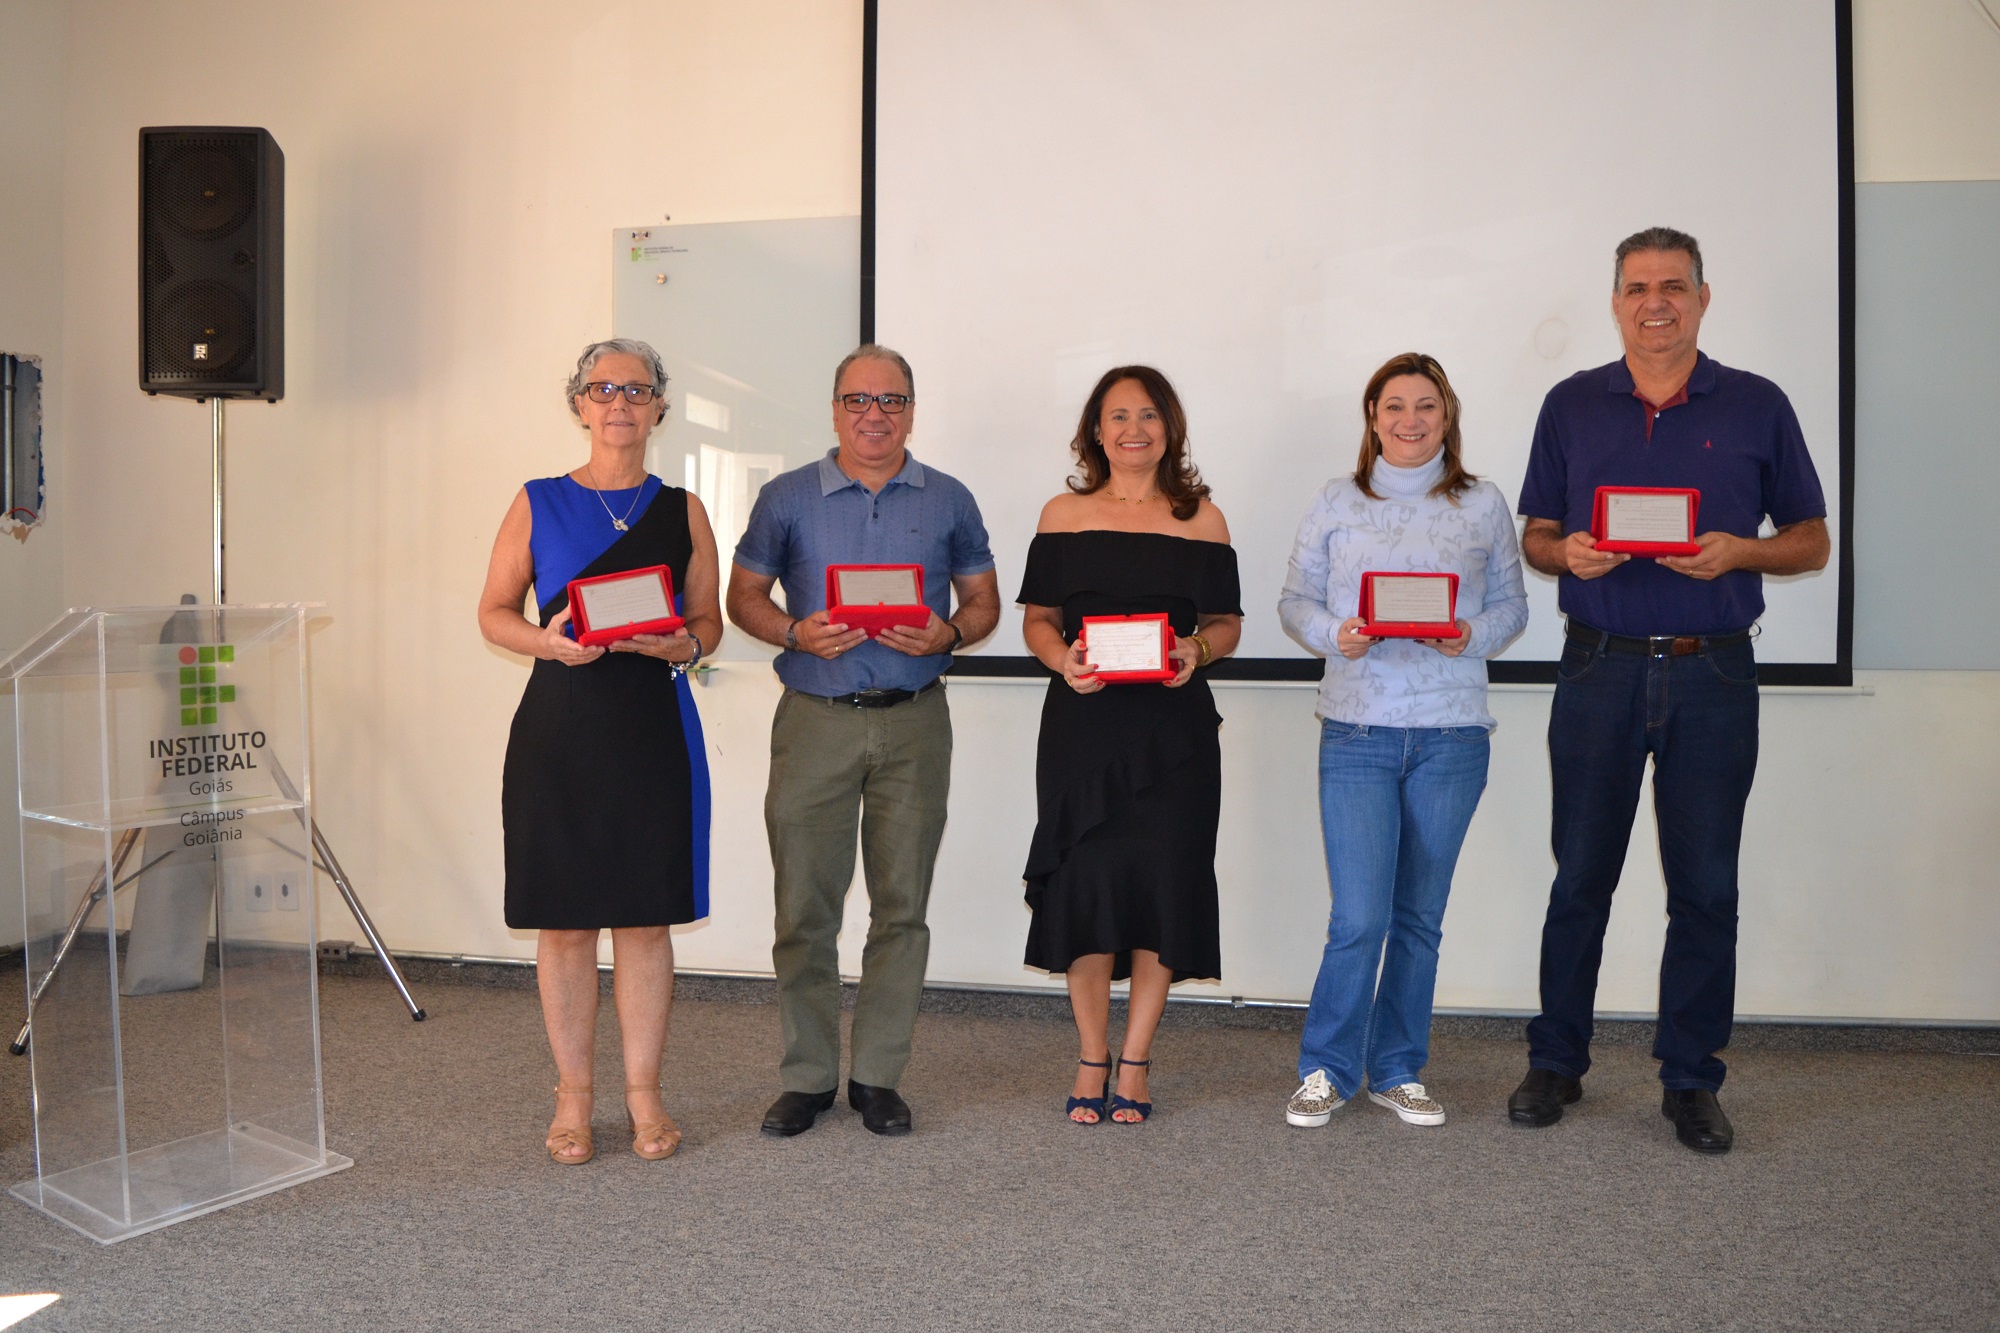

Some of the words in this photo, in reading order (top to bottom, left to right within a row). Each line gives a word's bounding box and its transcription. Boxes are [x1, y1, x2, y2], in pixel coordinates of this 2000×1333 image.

[150, 731, 266, 758] INSTITUTO
[162, 752, 257, 777] FEDERAL
[189, 778, 233, 795] Goiás
[180, 809, 244, 826] Câmpus
[184, 827, 243, 847] Goiânia
